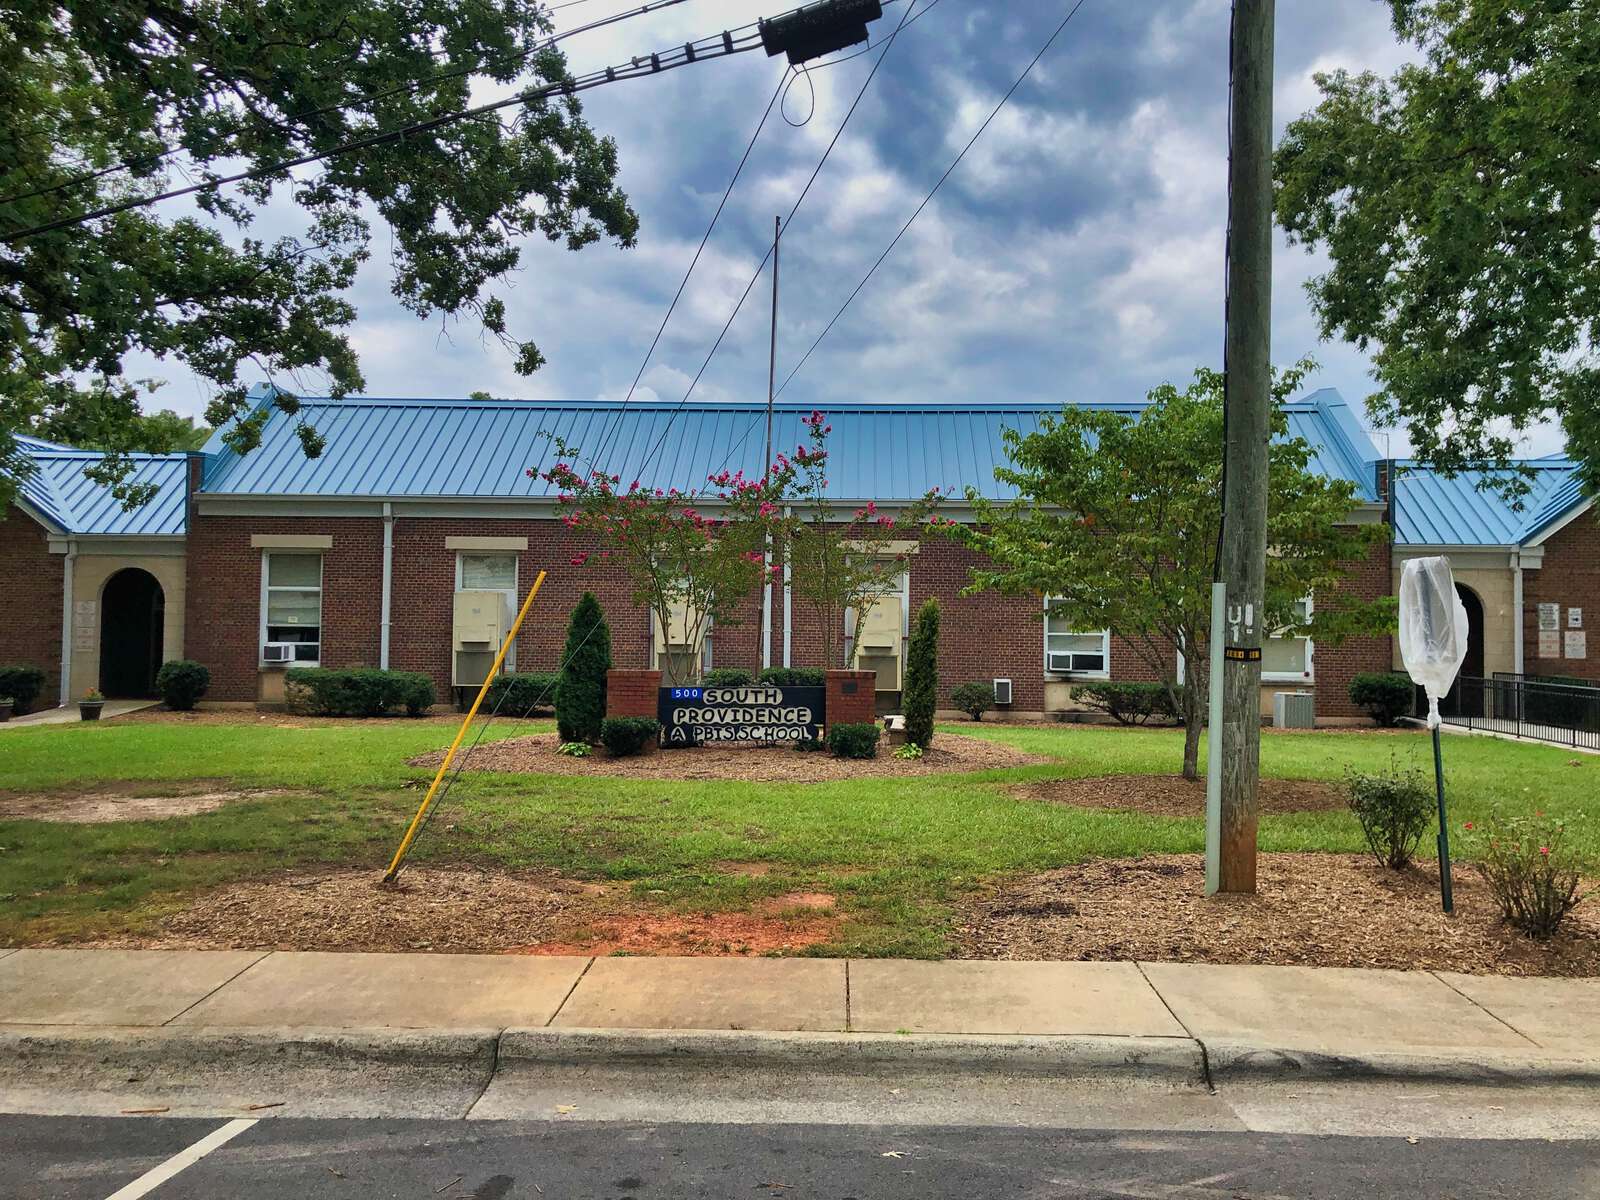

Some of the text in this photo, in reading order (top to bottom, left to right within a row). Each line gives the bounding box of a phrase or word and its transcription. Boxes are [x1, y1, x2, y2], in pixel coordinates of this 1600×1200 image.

[675, 689, 698, 698] 500
[705, 689, 778, 704] SOUTH
[676, 708, 808, 723] PROVIDENCE
[672, 726, 811, 741] A PBIS SCHOOL
